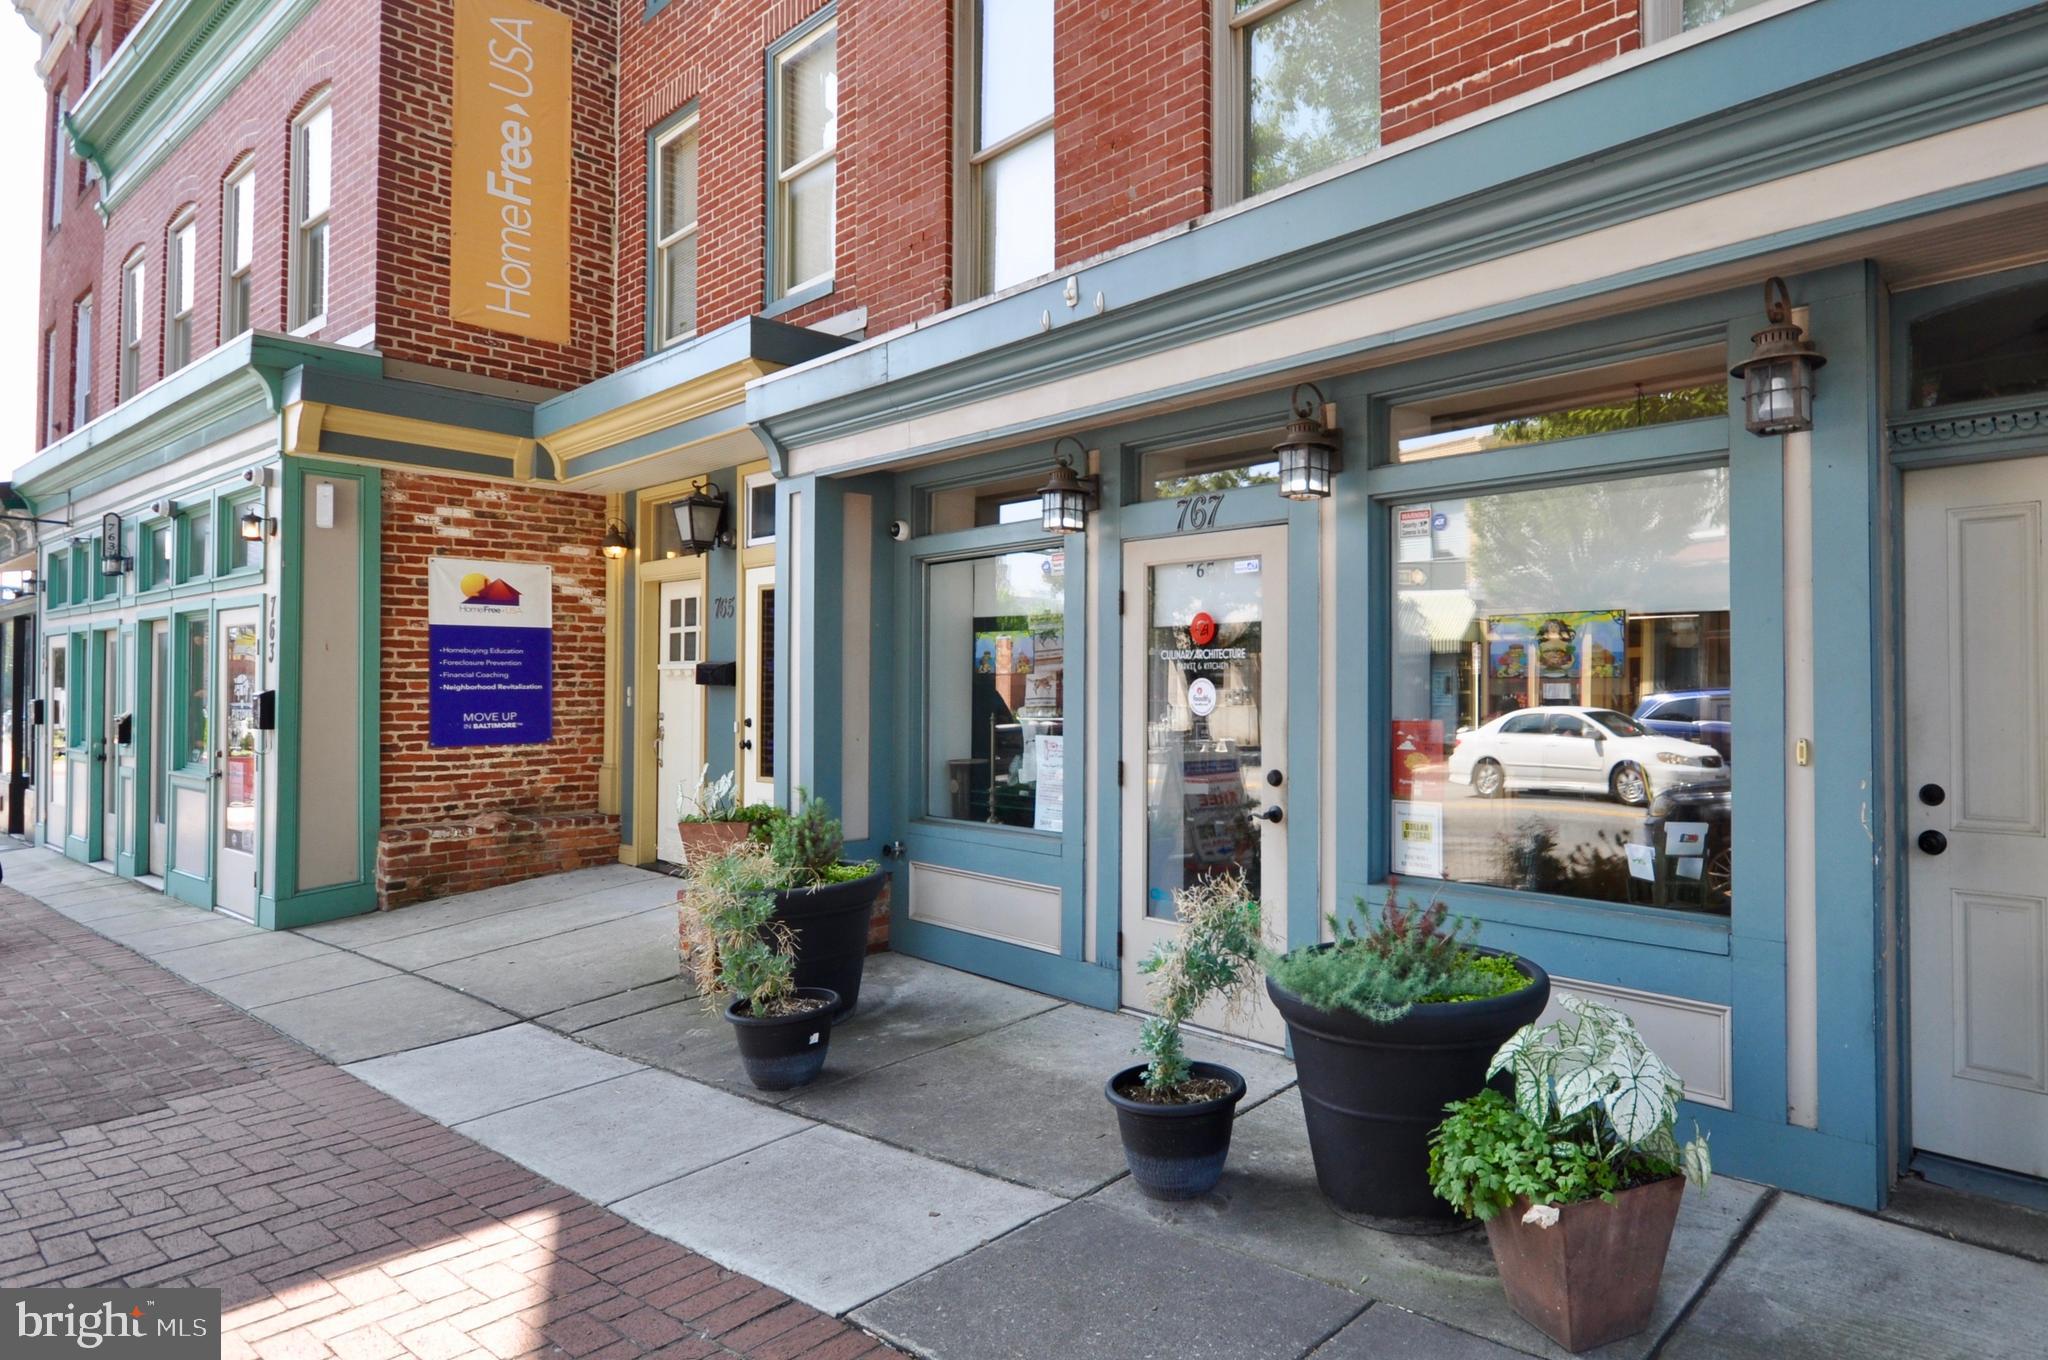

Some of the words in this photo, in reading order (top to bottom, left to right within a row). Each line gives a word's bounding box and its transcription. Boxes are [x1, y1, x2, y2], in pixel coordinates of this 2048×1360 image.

[488, 17, 533, 98] USA
[486, 120, 532, 319] HomeFree
[1176, 494, 1225, 532] 767
[714, 596, 736, 619] 765
[268, 595, 277, 664] 763
[443, 647, 488, 655] Homebuying
[1161, 649, 1194, 660] CULINARY
[1193, 647, 1247, 659] ARCHITECTURE
[476, 671, 509, 680] Coaching
[443, 683, 497, 692] Neighborhood
[497, 683, 543, 691] Revitalization
[463, 712, 499, 722] MOVE
[502, 712, 518, 722] UP
